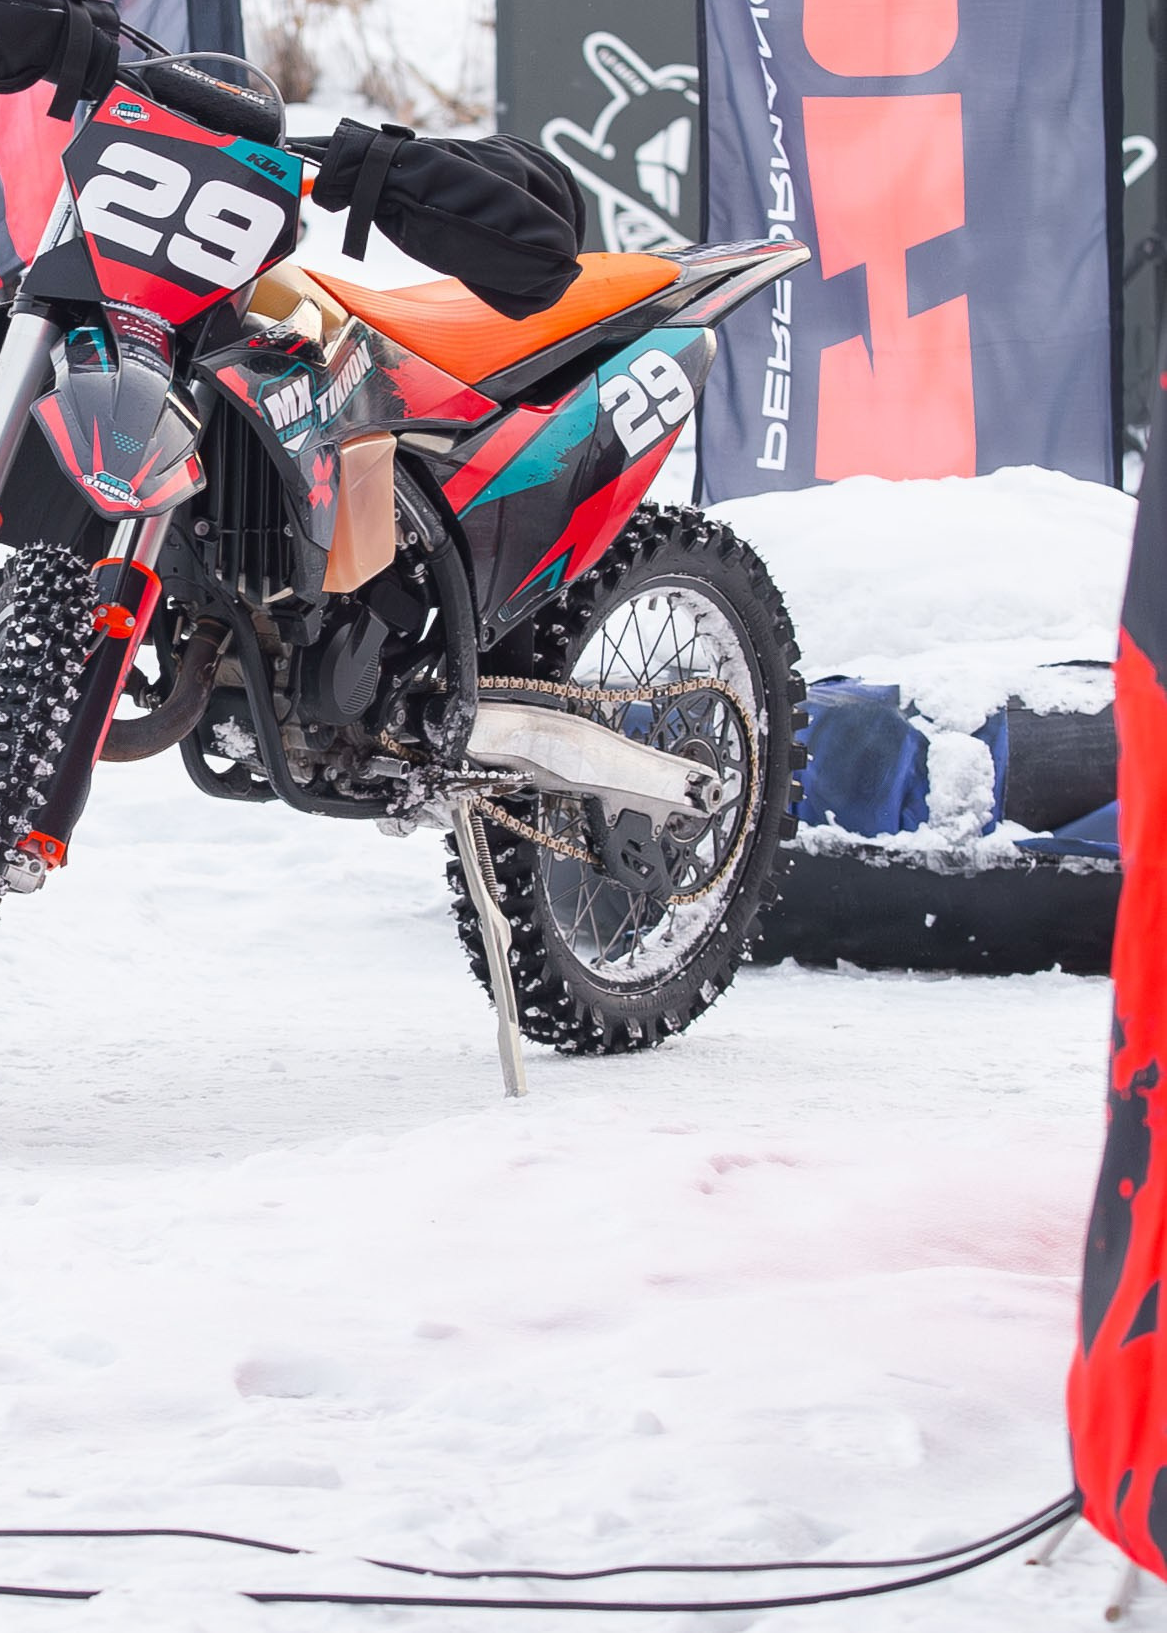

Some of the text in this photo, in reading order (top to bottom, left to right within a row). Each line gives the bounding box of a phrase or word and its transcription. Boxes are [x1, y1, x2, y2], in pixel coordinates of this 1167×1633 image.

[241, 91, 266, 105] RACE
[245, 152, 289, 181] KTM
[77, 141, 285, 290] 29
[263, 374, 314, 431] MX
[315, 339, 373, 424] TIKHON
[598, 349, 695, 458] 29
[275, 414, 314, 444] TEAM
[84, 476, 140, 506] TIKHON
